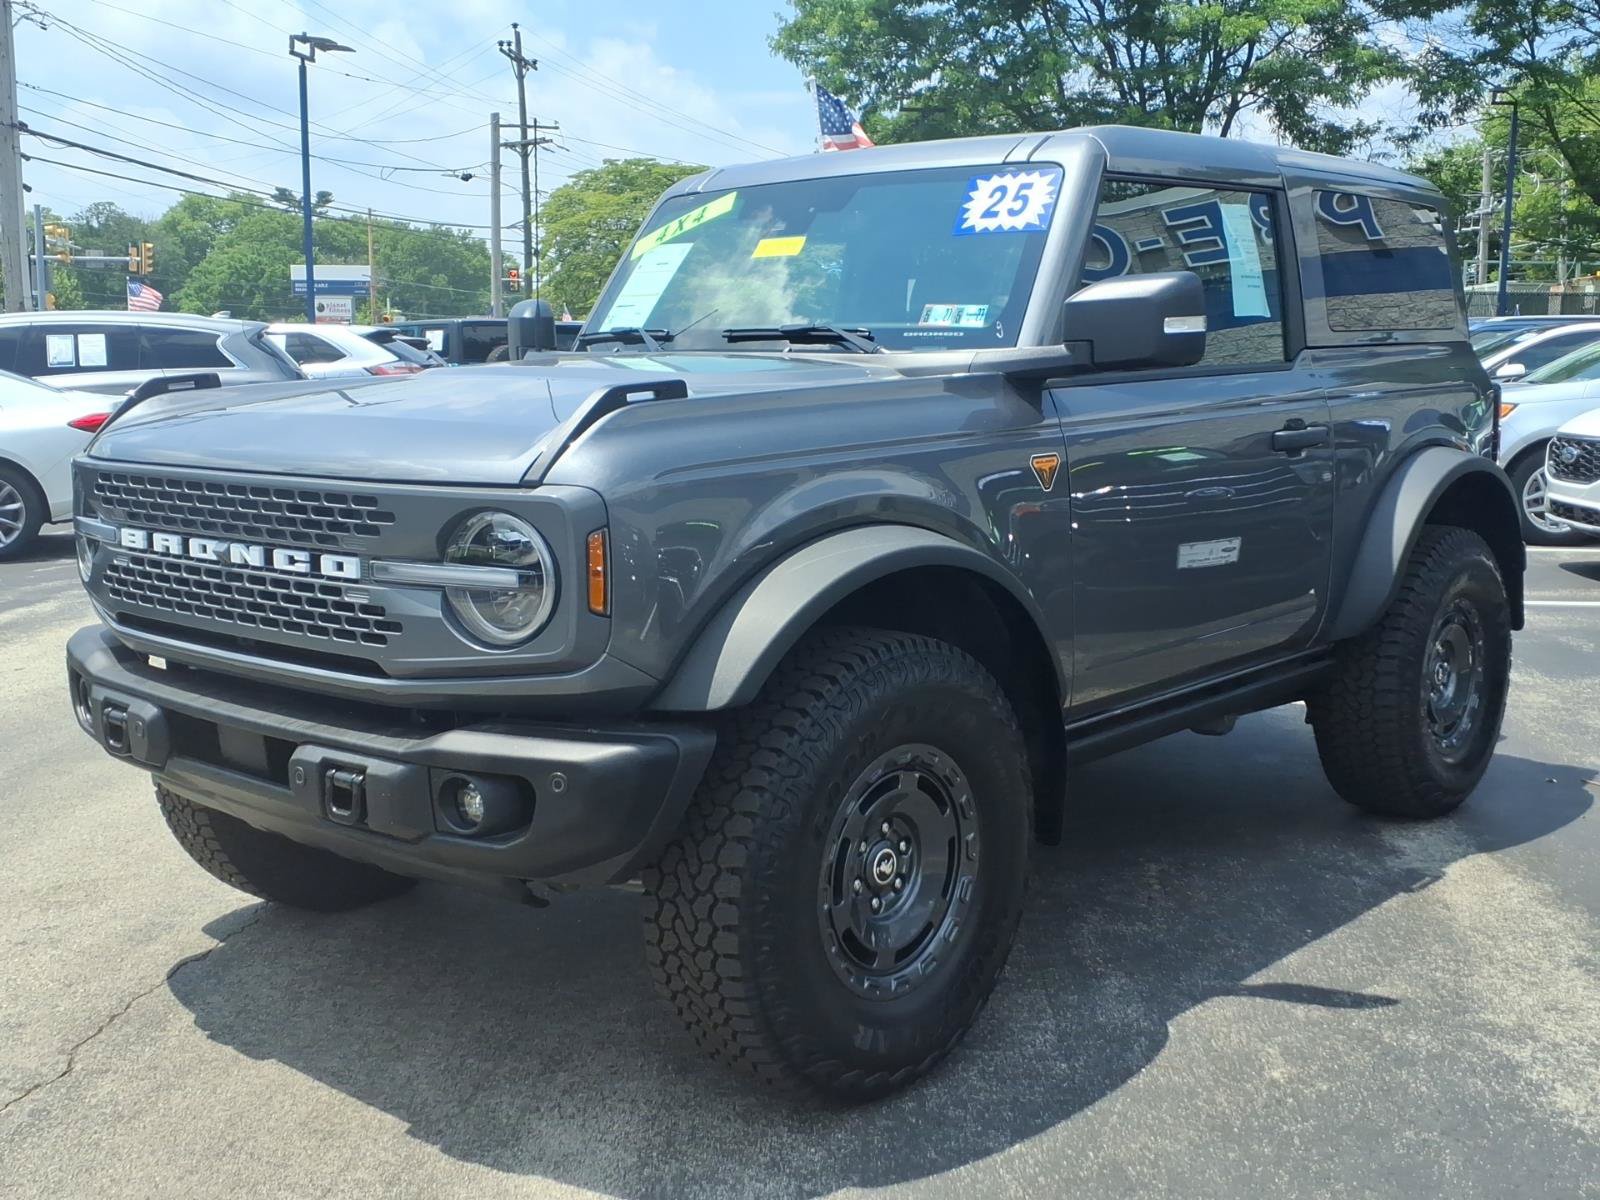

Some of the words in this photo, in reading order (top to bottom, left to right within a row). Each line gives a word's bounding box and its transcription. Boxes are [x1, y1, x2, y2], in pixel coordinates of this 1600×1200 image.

[979, 182, 1035, 219] 25
[655, 205, 708, 244] 4X4
[120, 527, 362, 580] BRONCO
